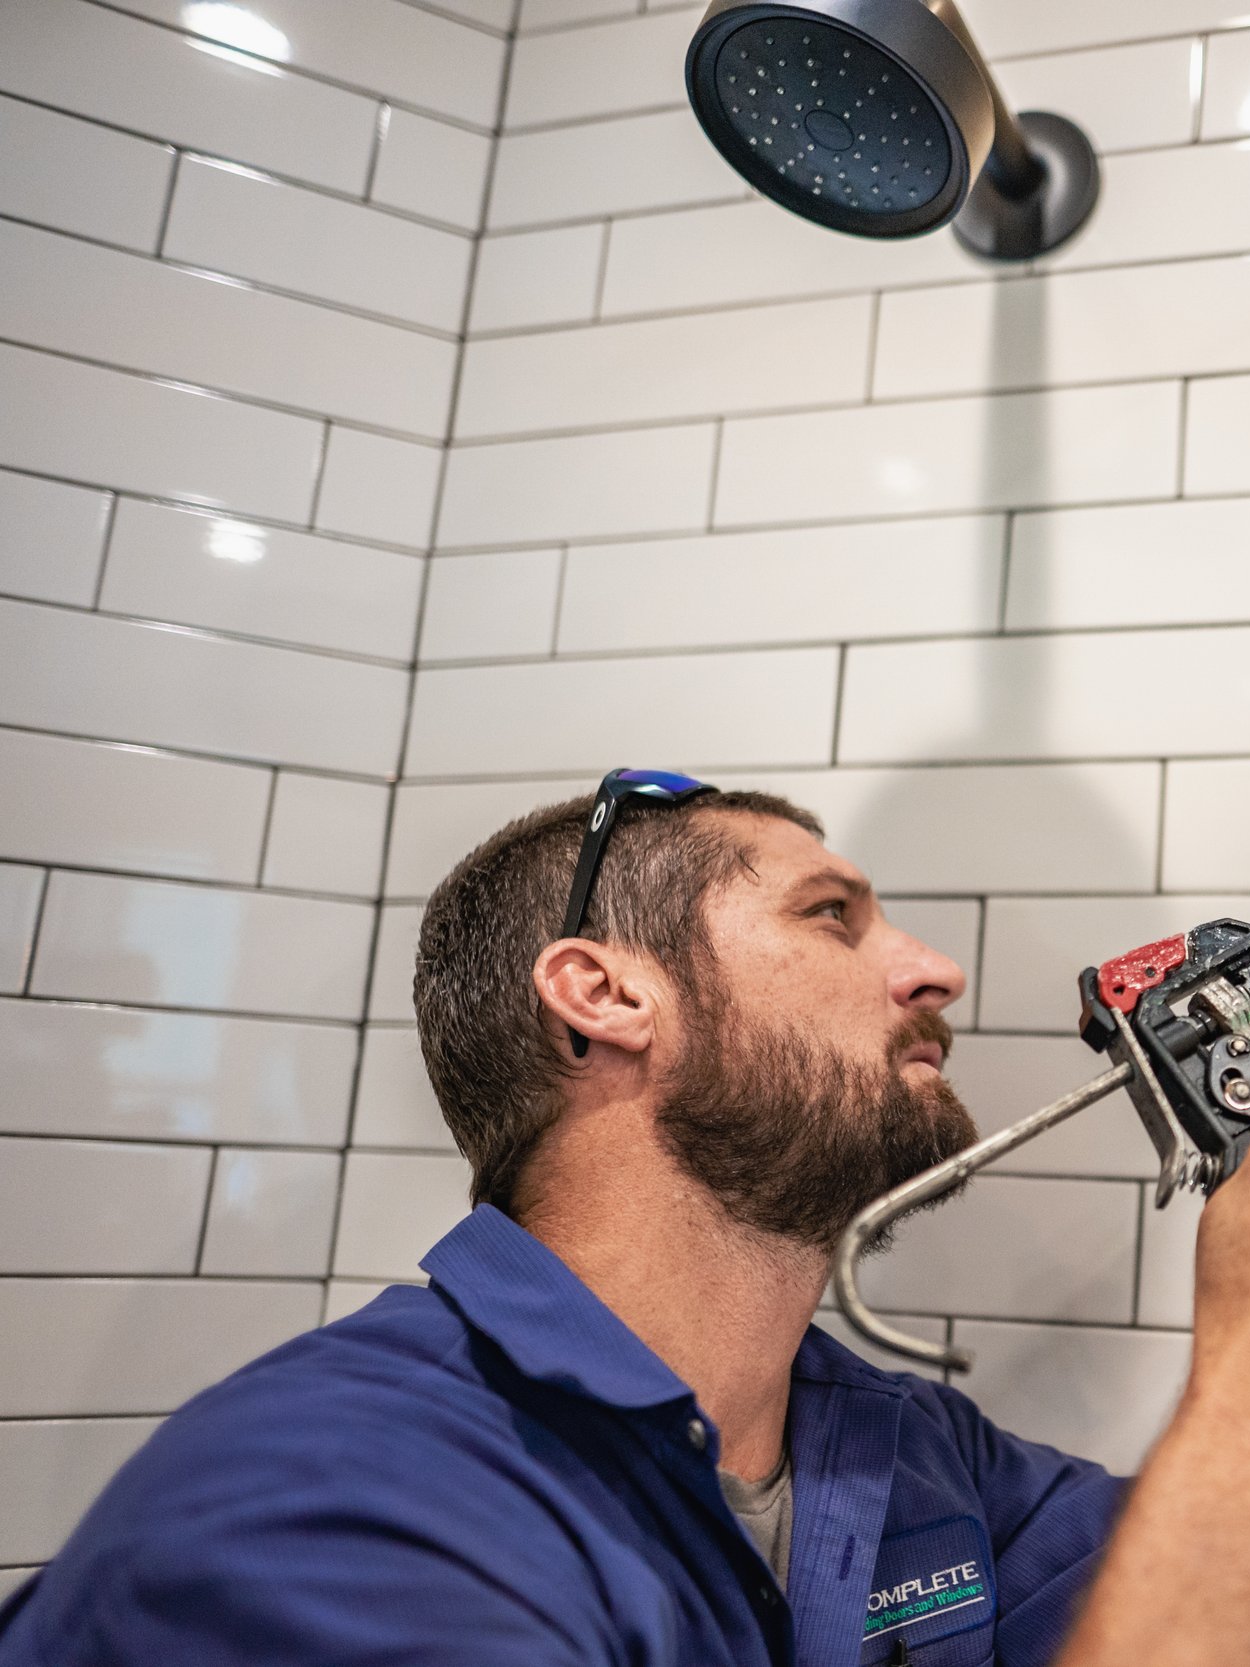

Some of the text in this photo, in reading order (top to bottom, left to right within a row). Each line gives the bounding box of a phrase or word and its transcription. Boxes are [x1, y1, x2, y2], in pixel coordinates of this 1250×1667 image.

[885, 1605, 914, 1624] Doors
[914, 1597, 934, 1613] and
[936, 1583, 984, 1606] Windows
